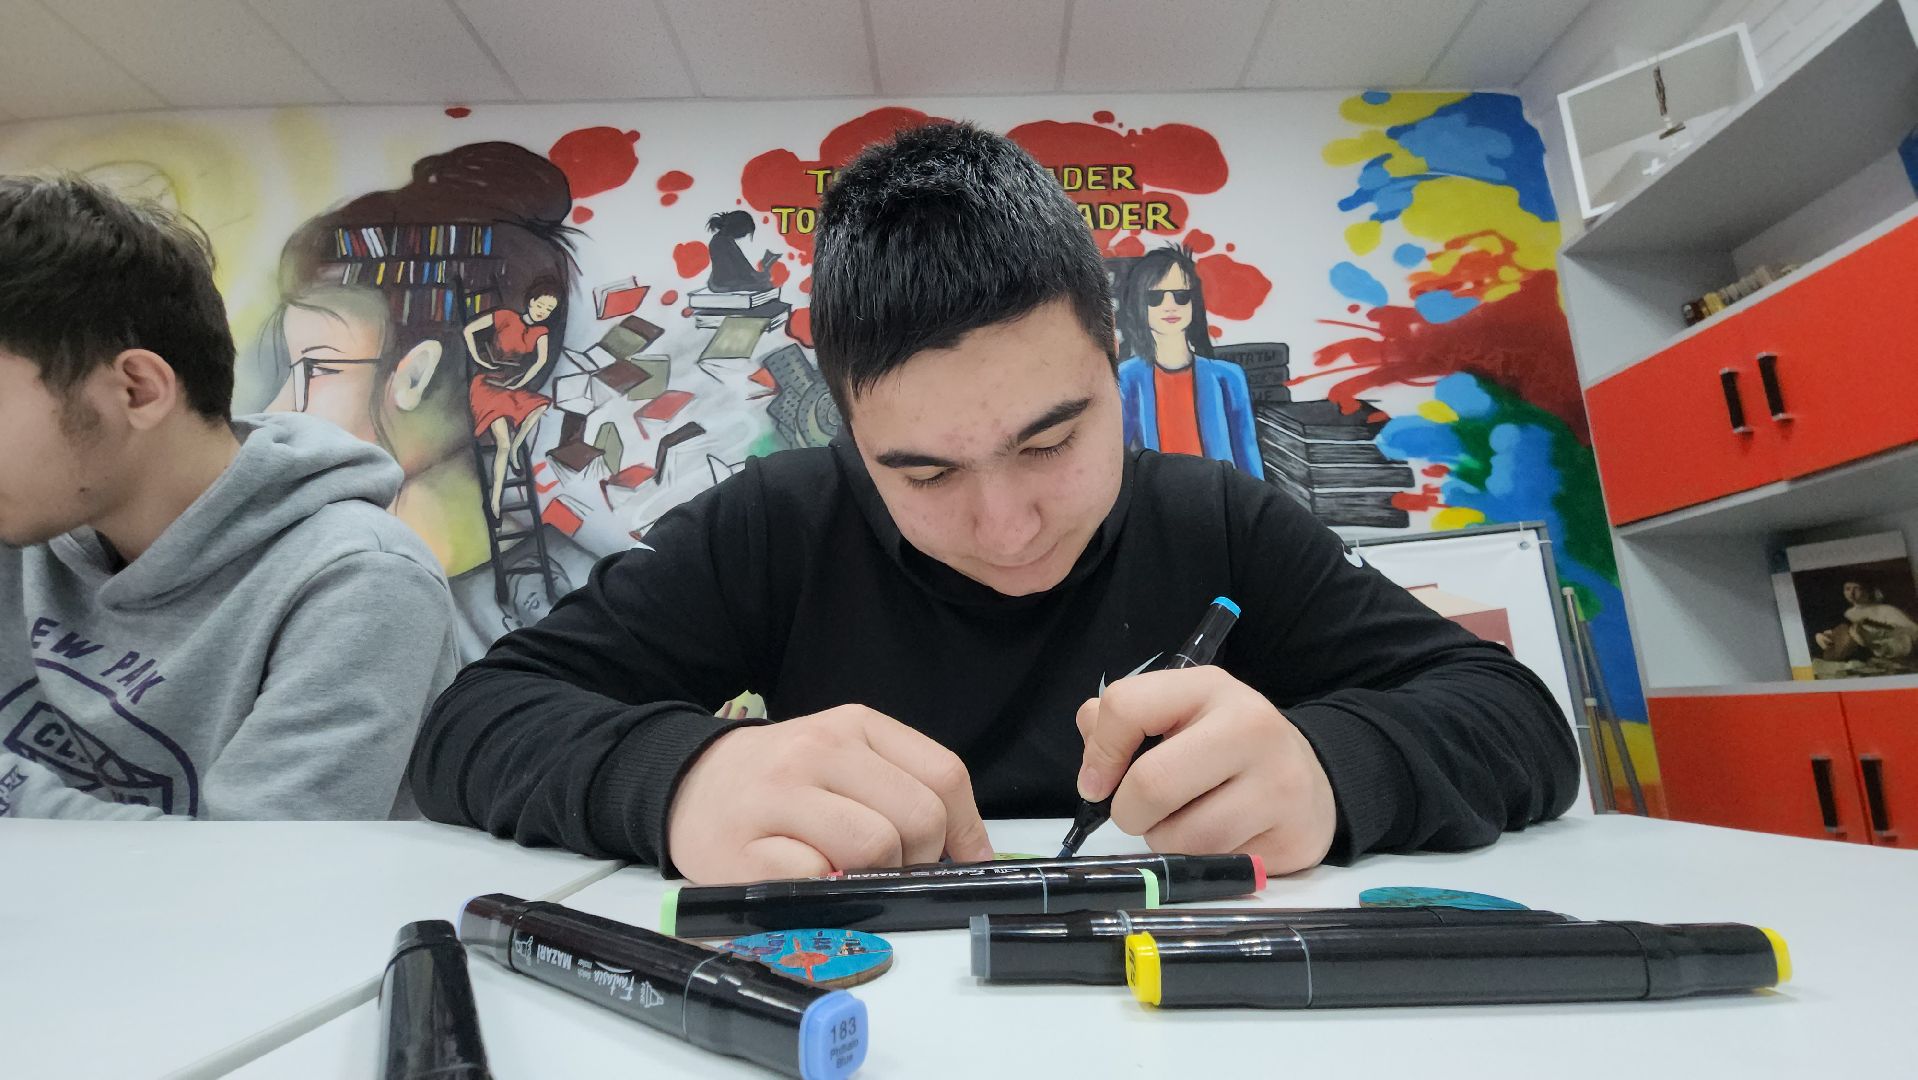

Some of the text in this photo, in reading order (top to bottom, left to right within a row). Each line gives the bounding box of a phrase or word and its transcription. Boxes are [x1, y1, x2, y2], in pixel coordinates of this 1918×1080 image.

[1045, 166, 1136, 190] DER
[1077, 202, 1178, 230] ADER
[31, 616, 104, 659] EW
[831, 1016, 857, 1044] 183
